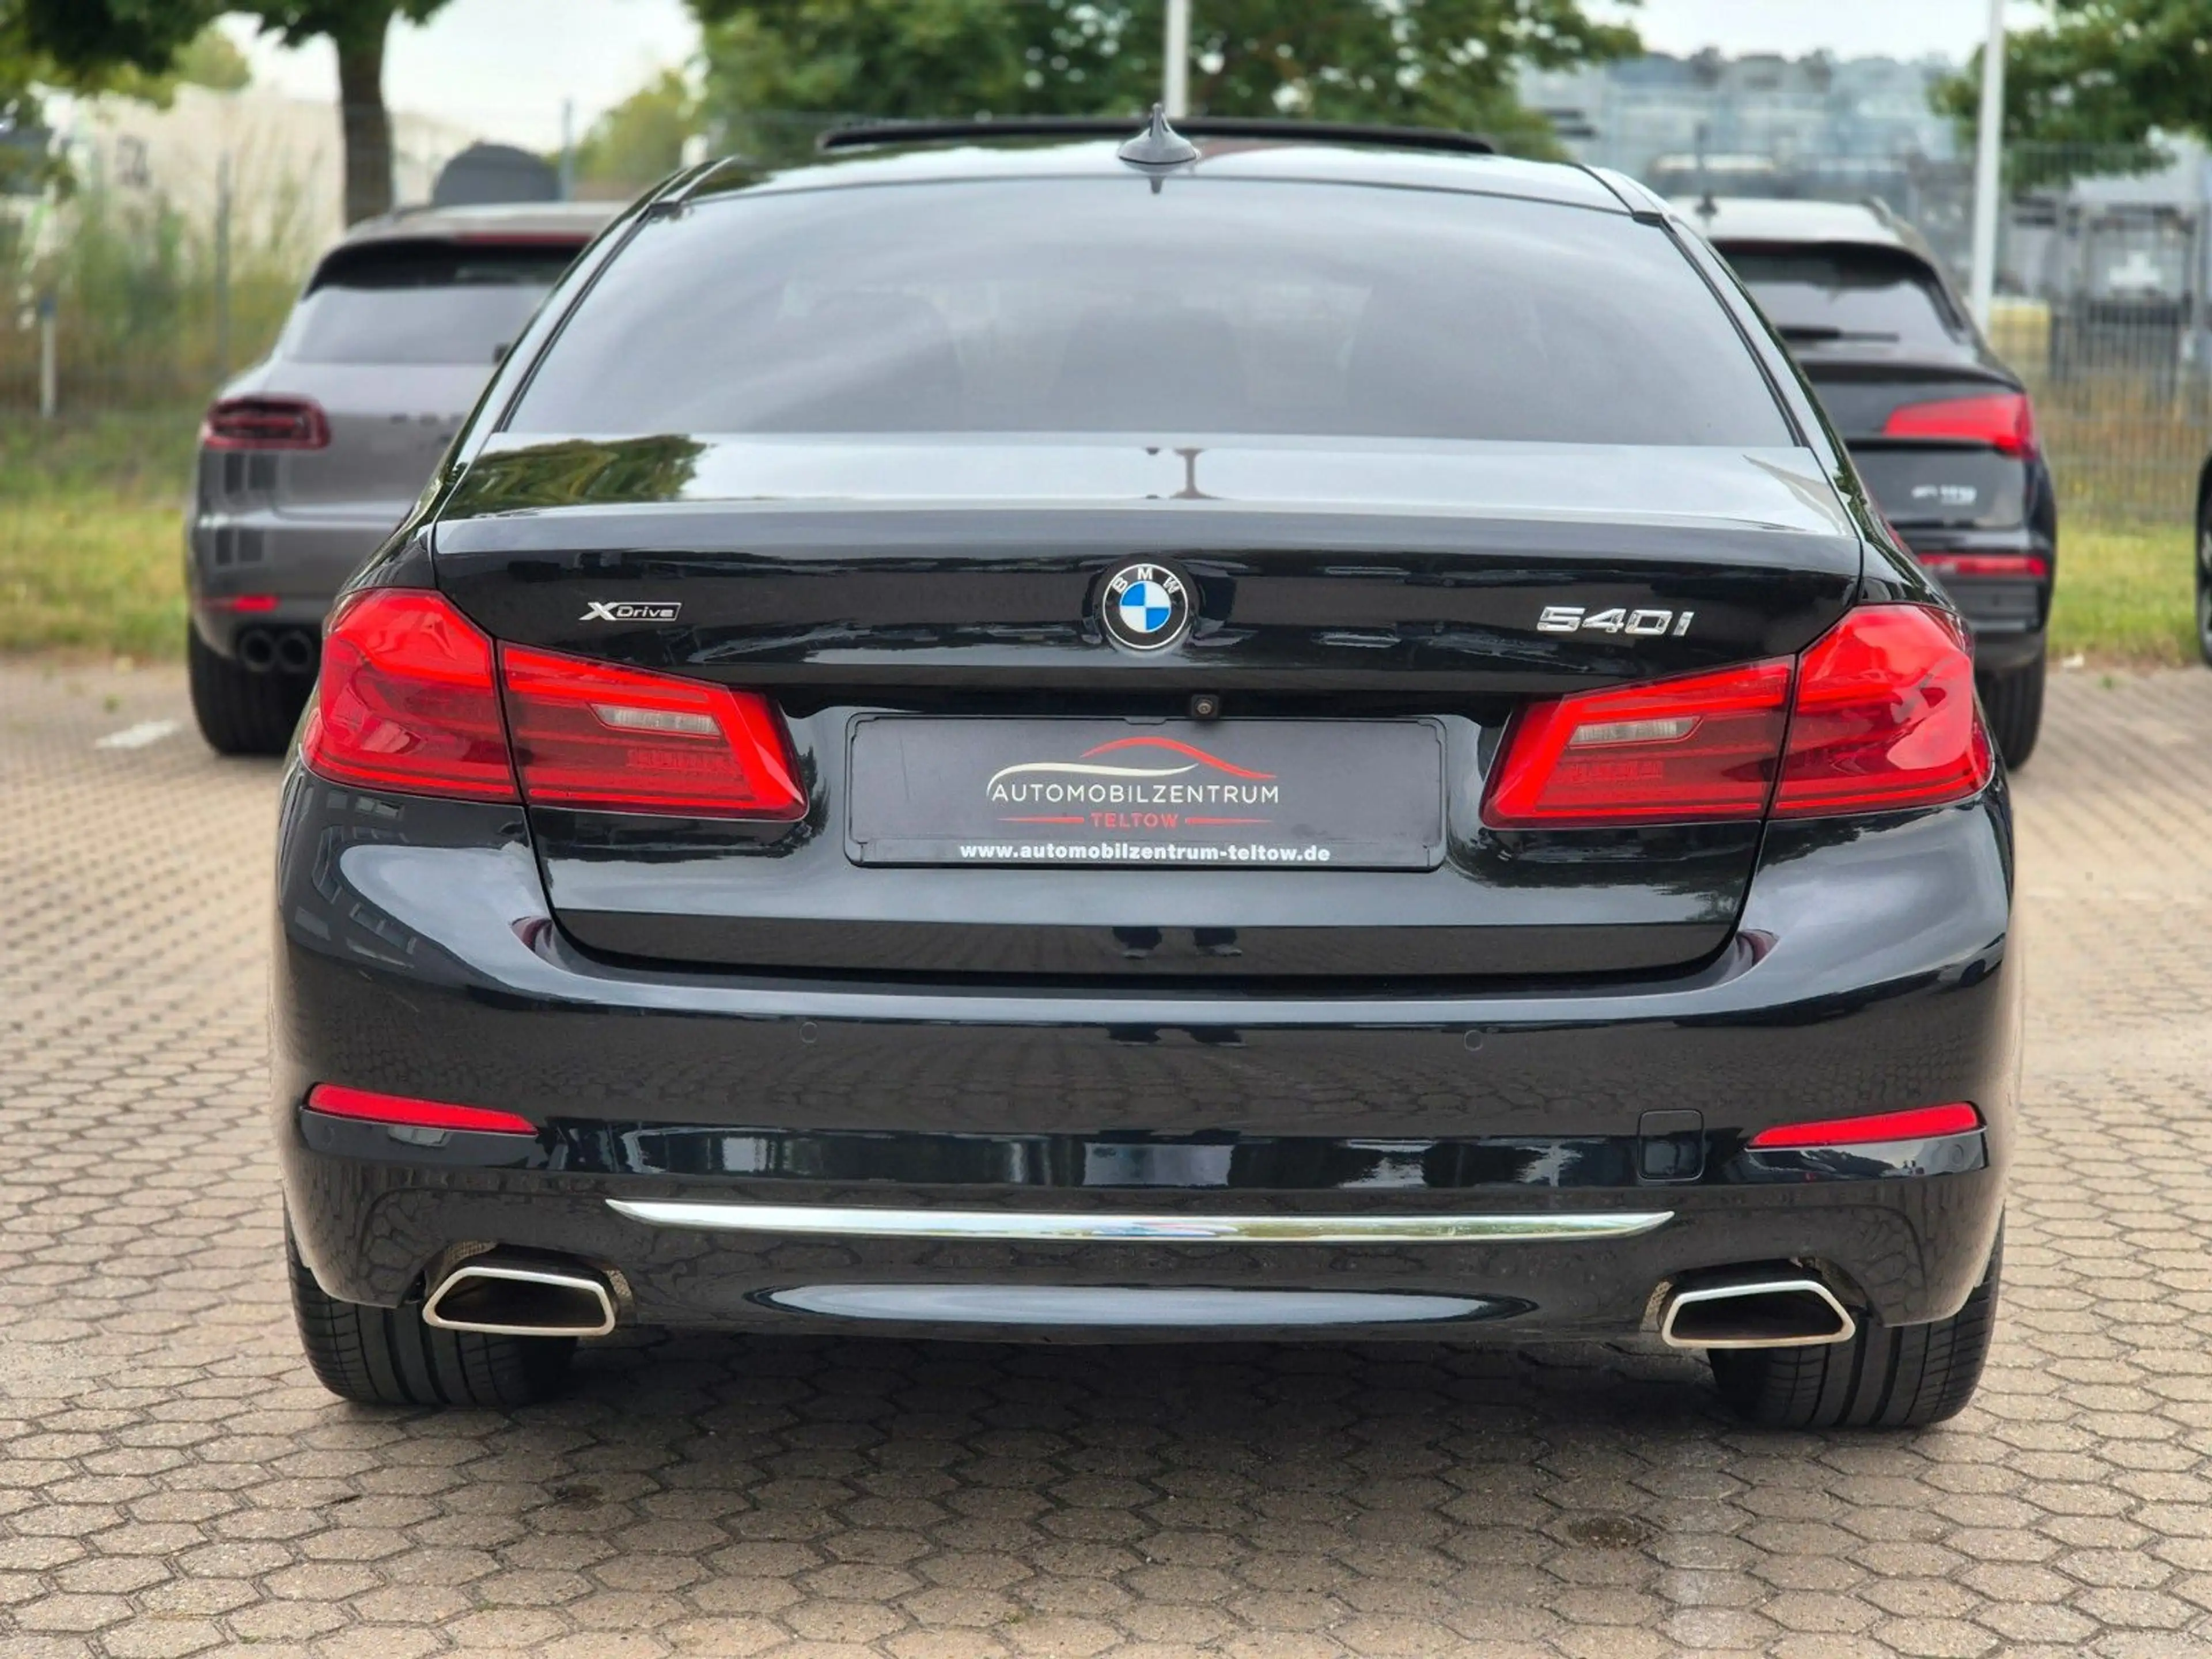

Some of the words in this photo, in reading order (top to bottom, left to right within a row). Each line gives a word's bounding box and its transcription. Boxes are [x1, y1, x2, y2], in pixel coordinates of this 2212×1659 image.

[1111, 567, 1181, 594] BMW
[991, 784, 1279, 804] AUTOMOBILZENTRUM
[1090, 812, 1178, 828] TELTOW
[960, 843, 1331, 861] www.automobilzentrum-teltow.de
